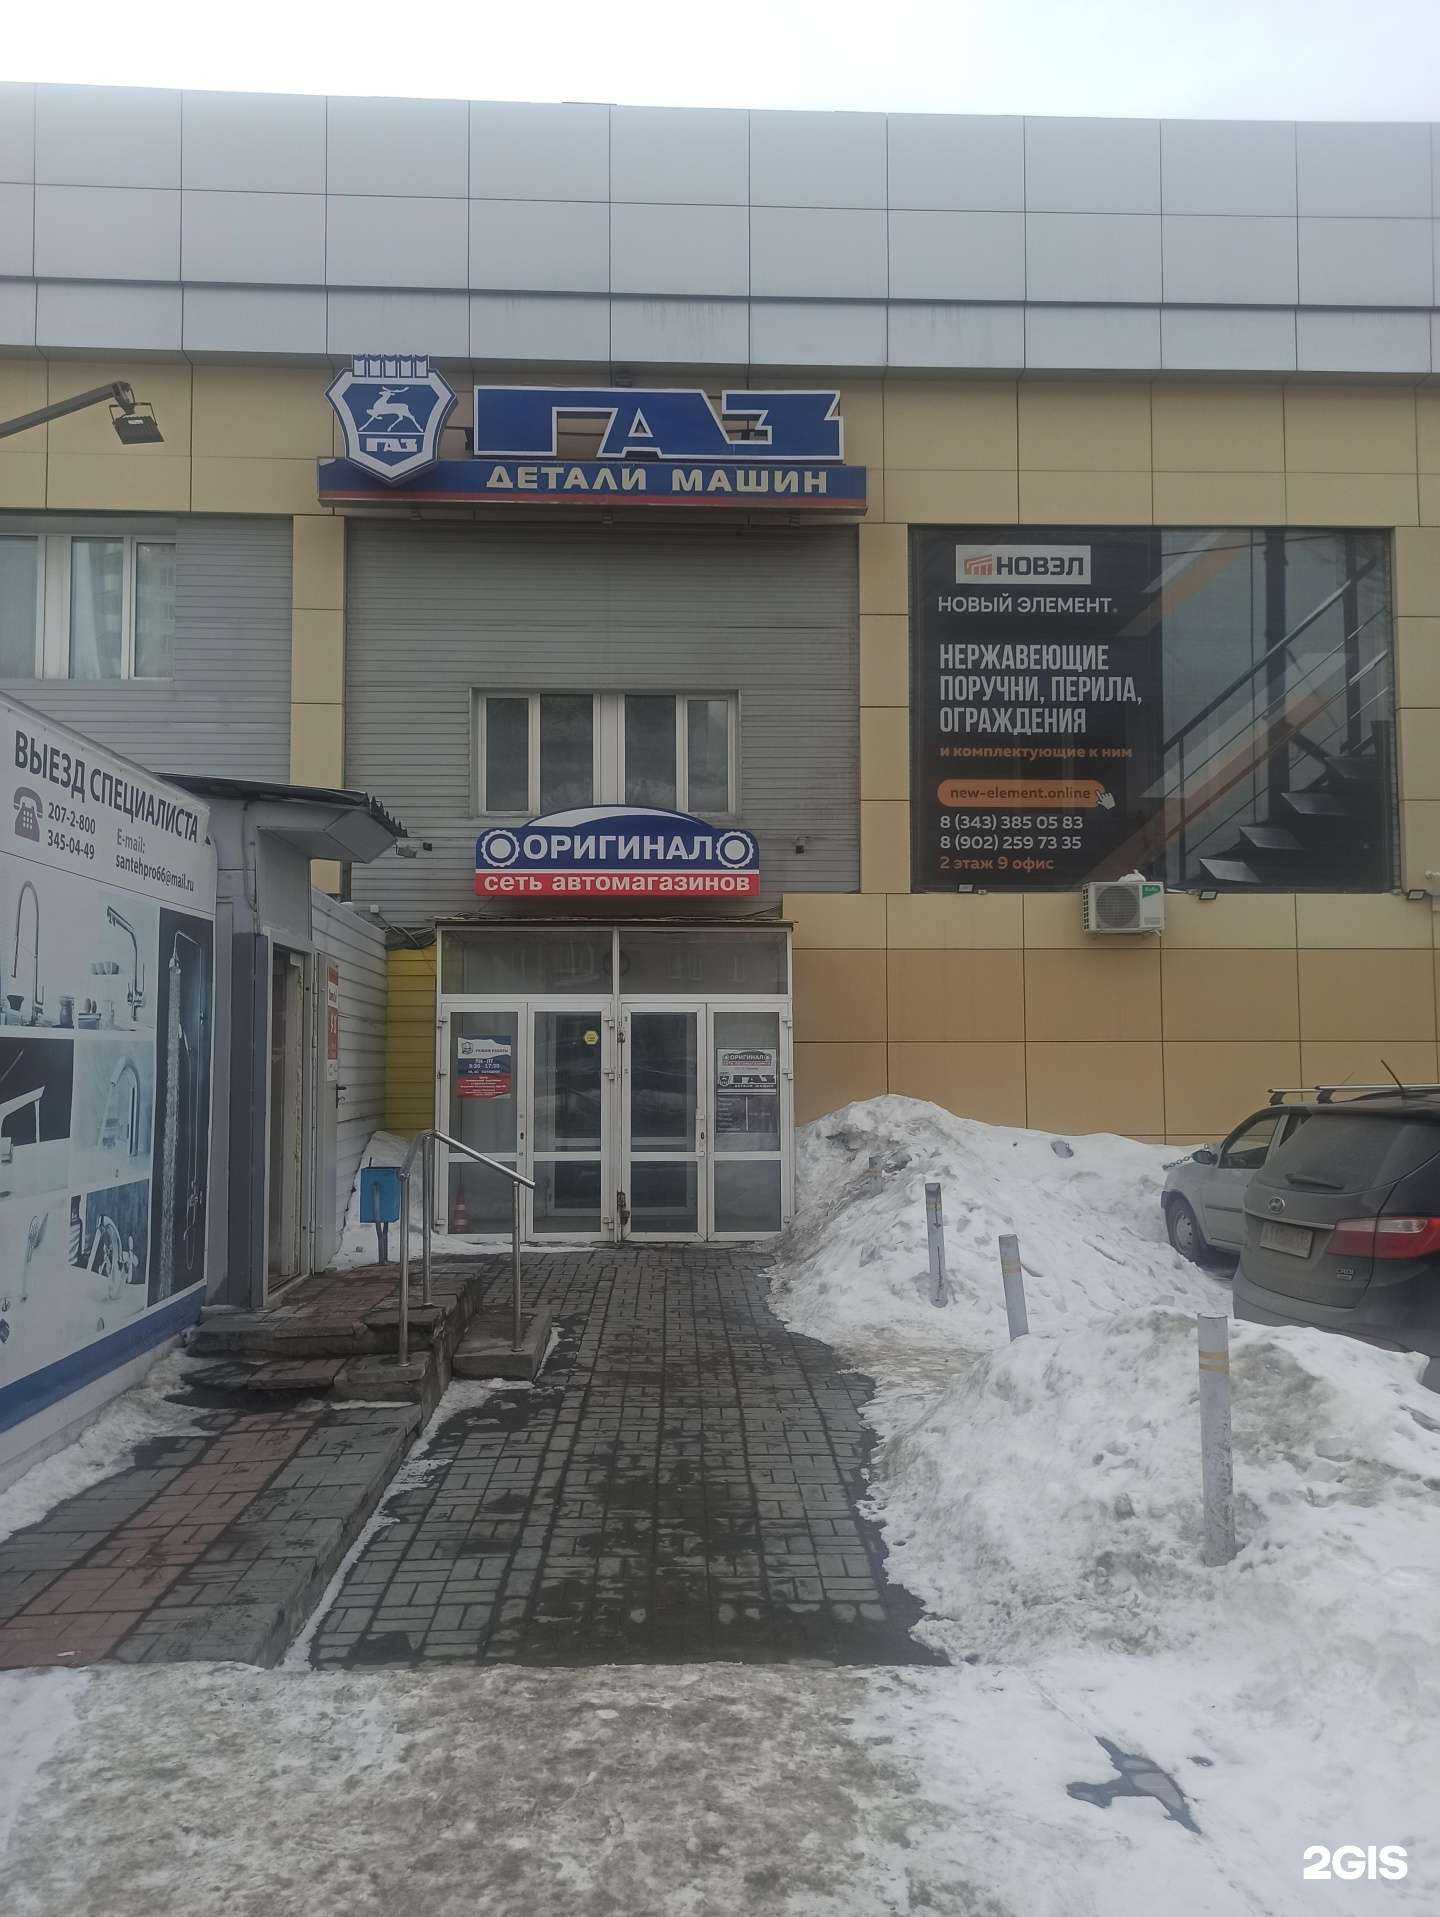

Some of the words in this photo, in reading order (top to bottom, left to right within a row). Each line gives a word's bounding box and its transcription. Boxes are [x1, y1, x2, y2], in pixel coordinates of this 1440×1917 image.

[473, 385, 845, 462] ГАЗ
[366, 437, 418, 453] ГАЗ
[486, 465, 647, 491] ДЕТАЛИ
[671, 468, 829, 494] МАШИН
[996, 556, 1085, 576] НОВЭЛ
[938, 593, 1013, 613] НОВЫЙ
[939, 643, 1110, 672] НЕРЖАВЕЮЩИЕ
[939, 675, 1045, 705] ПОРУЧНИ,
[1051, 676, 1143, 705] ПЕРИЛА,
[939, 706, 1087, 736] ОГРАЖДЕНИЯ
[940, 747, 950, 757] и
[953, 747, 1086, 760] комплектующие
[1089, 747, 1098, 758] к
[1102, 748, 1133, 759] ним
[15, 730, 86, 804] ВЫЕЗД
[90, 768, 199, 843] СПЕЦИАЛИСТА
[950, 786, 1091, 800] new-element.online
[48, 802, 96, 835] 207-2-800
[940, 816, 951, 829] 8
[954, 814, 997, 832] (343)
[1000, 816, 1033, 829] 385
[1036, 816, 1058, 829] 05
[1062, 816, 1084, 829] 83
[47, 829, 96, 860] 345-04-49
[117, 828, 146, 854] E-mail:
[522, 834, 713, 861] ОРИГИНАЛ
[940, 836, 951, 849] 8
[954, 834, 999, 851] (902)
[1002, 836, 1034, 849] 259
[1037, 836, 1058, 849] 73
[1061, 836, 1082, 849] 35
[115, 853, 195, 892] santehpro66@mail.ru
[940, 856, 950, 869] 2
[953, 858, 993, 870] этаж
[998, 857, 1008, 870] 9
[1012, 857, 1054, 873] офис
[483, 875, 543, 891] сеть
[551, 875, 750, 892] автомагазинов
